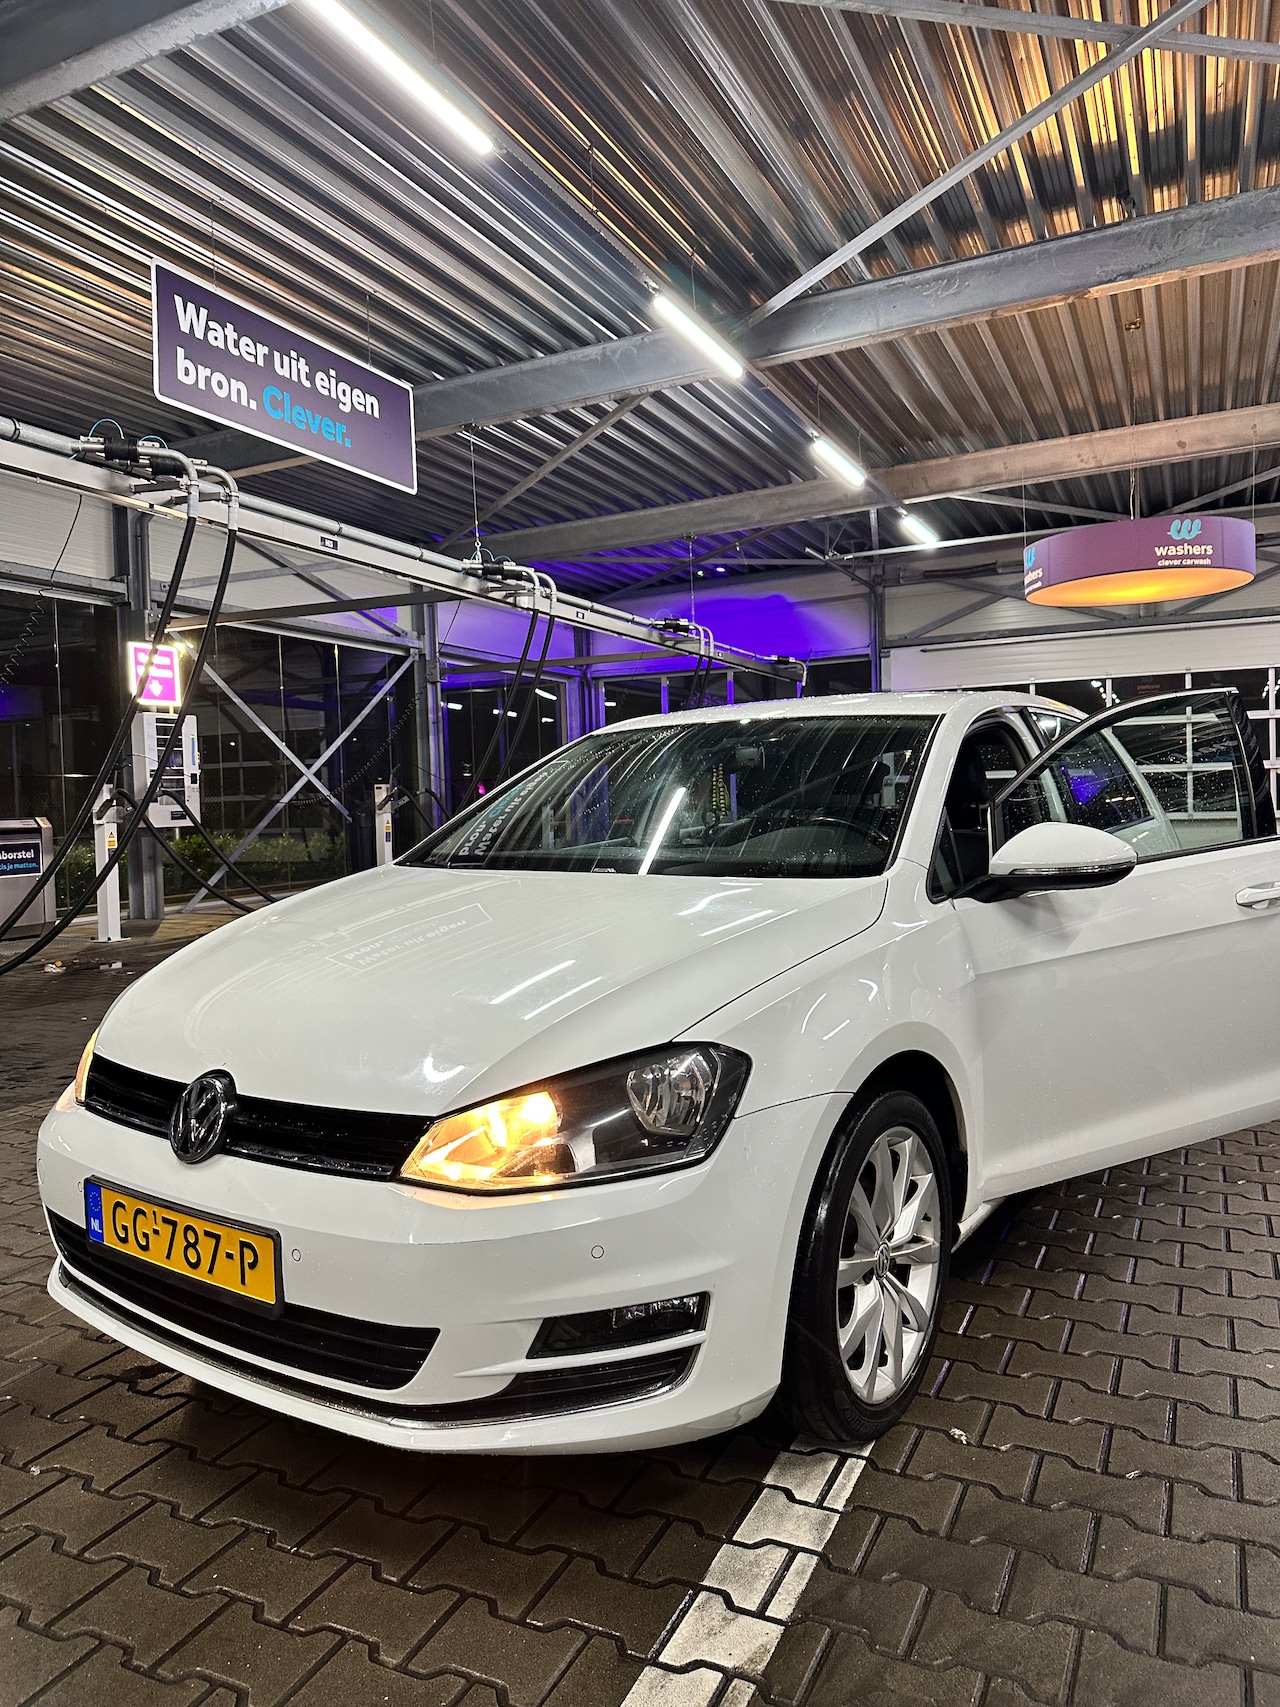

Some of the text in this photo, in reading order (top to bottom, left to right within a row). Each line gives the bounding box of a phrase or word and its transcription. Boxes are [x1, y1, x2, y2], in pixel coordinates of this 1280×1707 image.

[173, 294, 380, 419] Water uit eigen
[176, 346, 352, 449] bron. Clever.
[1154, 542, 1214, 557] washers
[1157, 557, 1212, 566] clever carwash
[90, 1200, 259, 1286] NL GG-787-P
